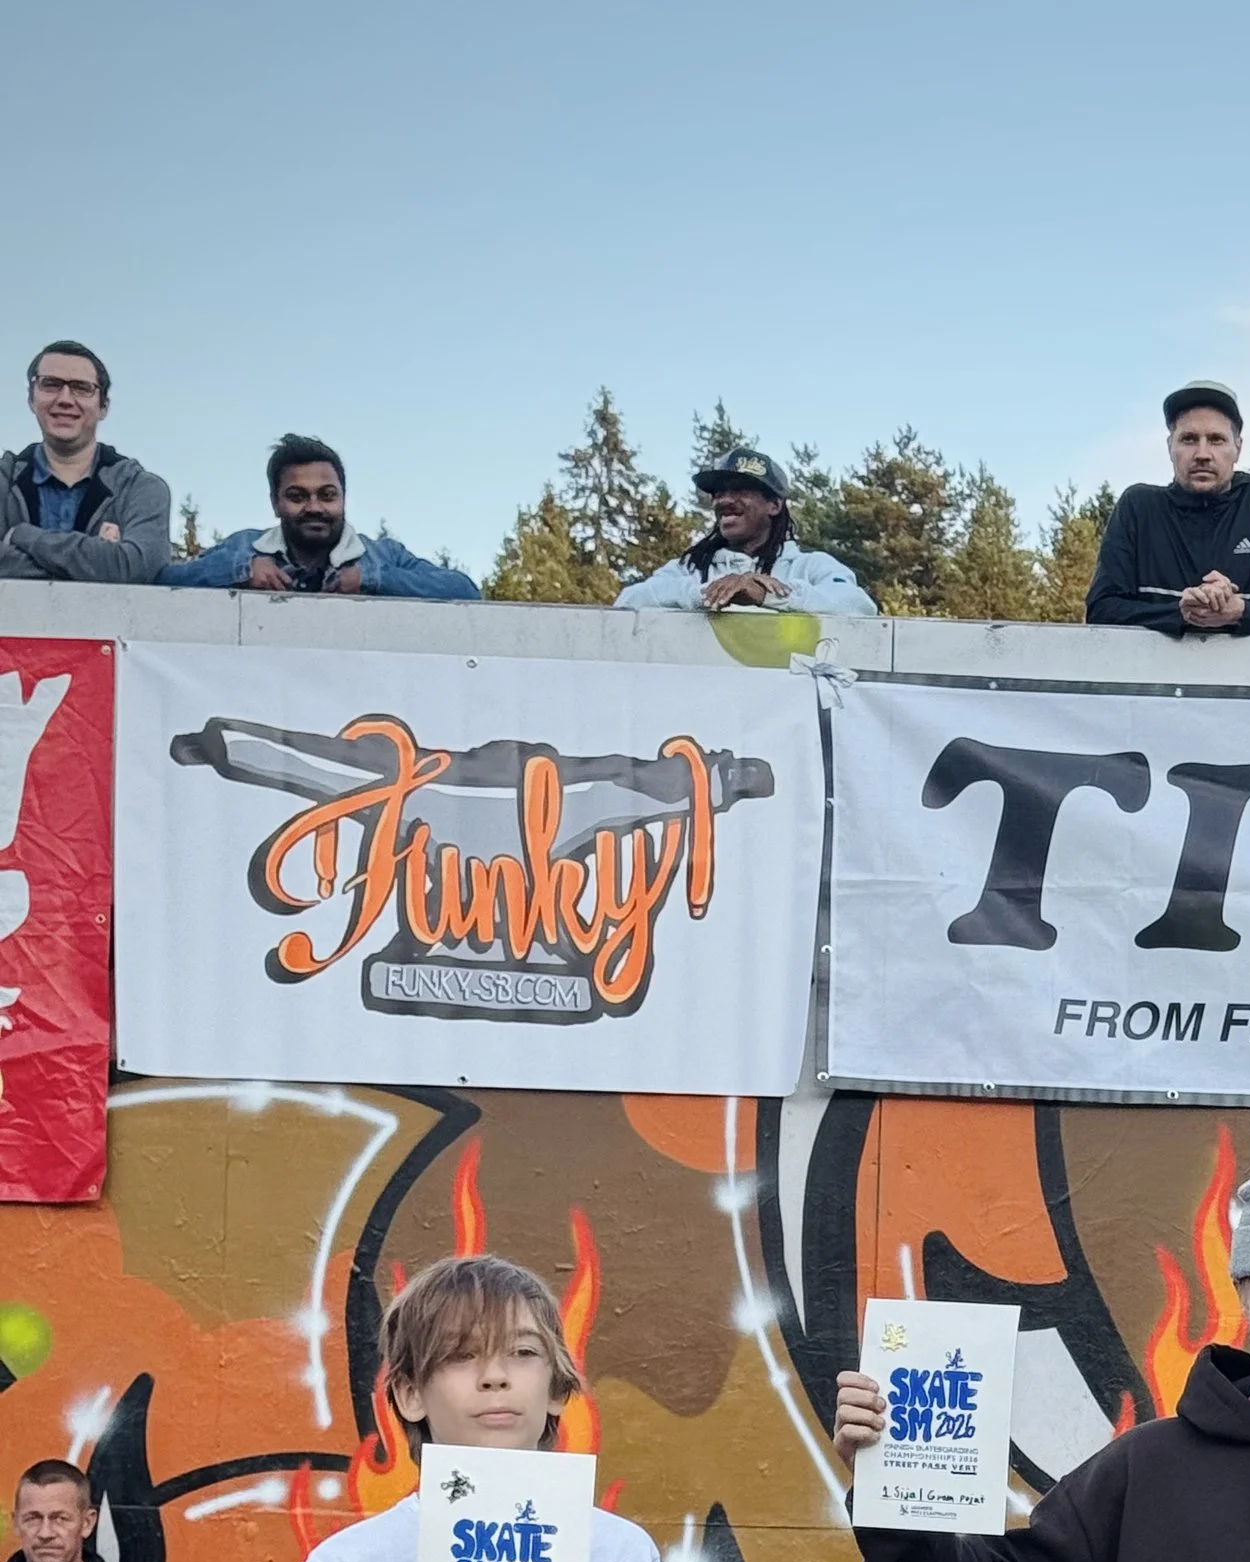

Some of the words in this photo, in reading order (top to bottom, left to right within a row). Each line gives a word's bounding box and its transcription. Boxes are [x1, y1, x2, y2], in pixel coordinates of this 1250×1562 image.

[1054, 998, 1207, 1042] FROM
[888, 1367, 983, 1411] SKATE
[889, 1405, 933, 1443] SM
[935, 1411, 976, 1440] 2026
